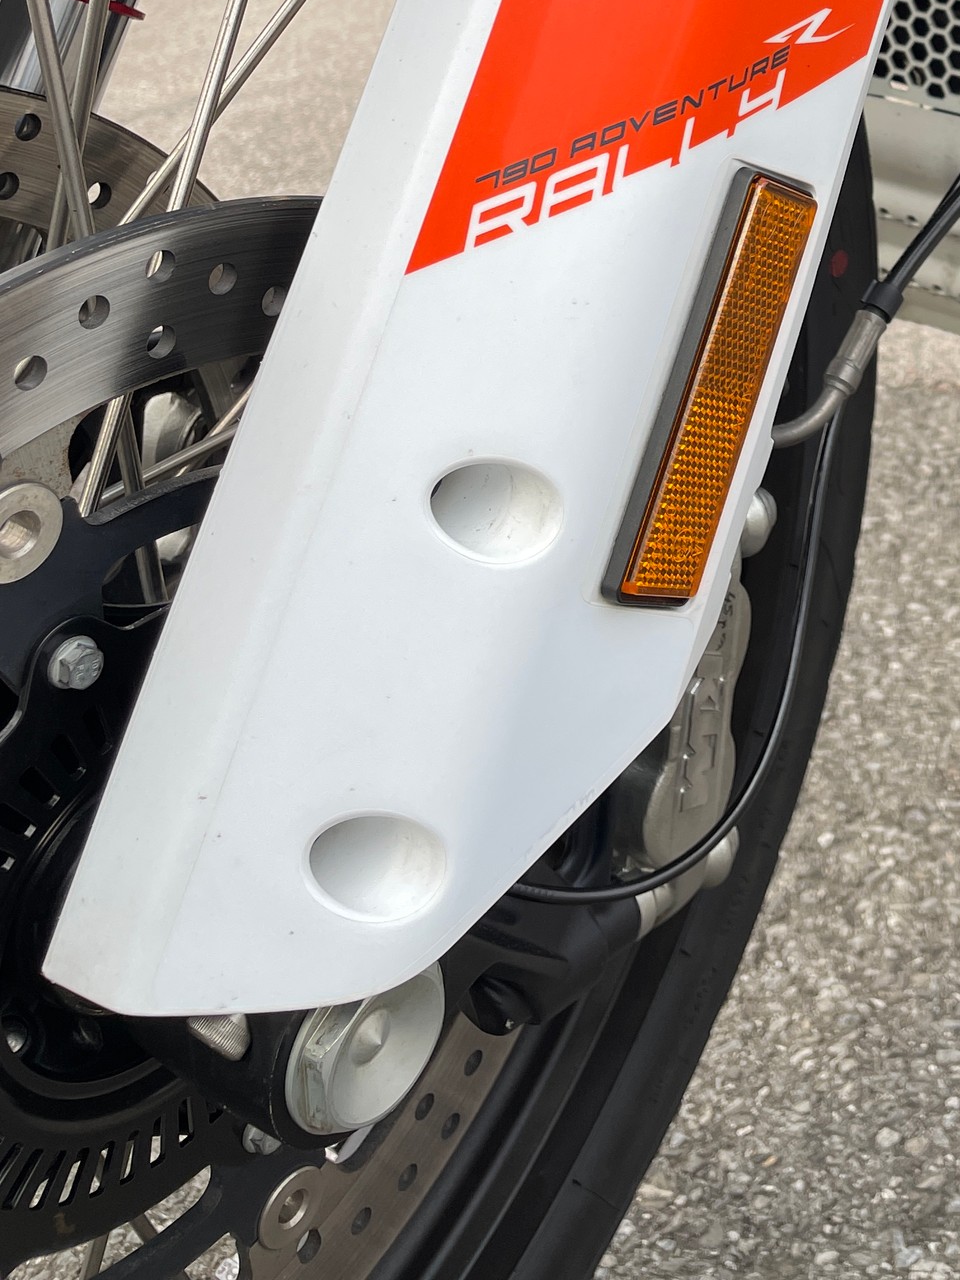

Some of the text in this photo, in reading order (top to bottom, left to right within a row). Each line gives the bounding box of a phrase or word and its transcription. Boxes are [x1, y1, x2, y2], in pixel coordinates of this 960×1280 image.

[463, 67, 787, 254] RALLY
[475, 44, 791, 189] 790 ADVENTURE
